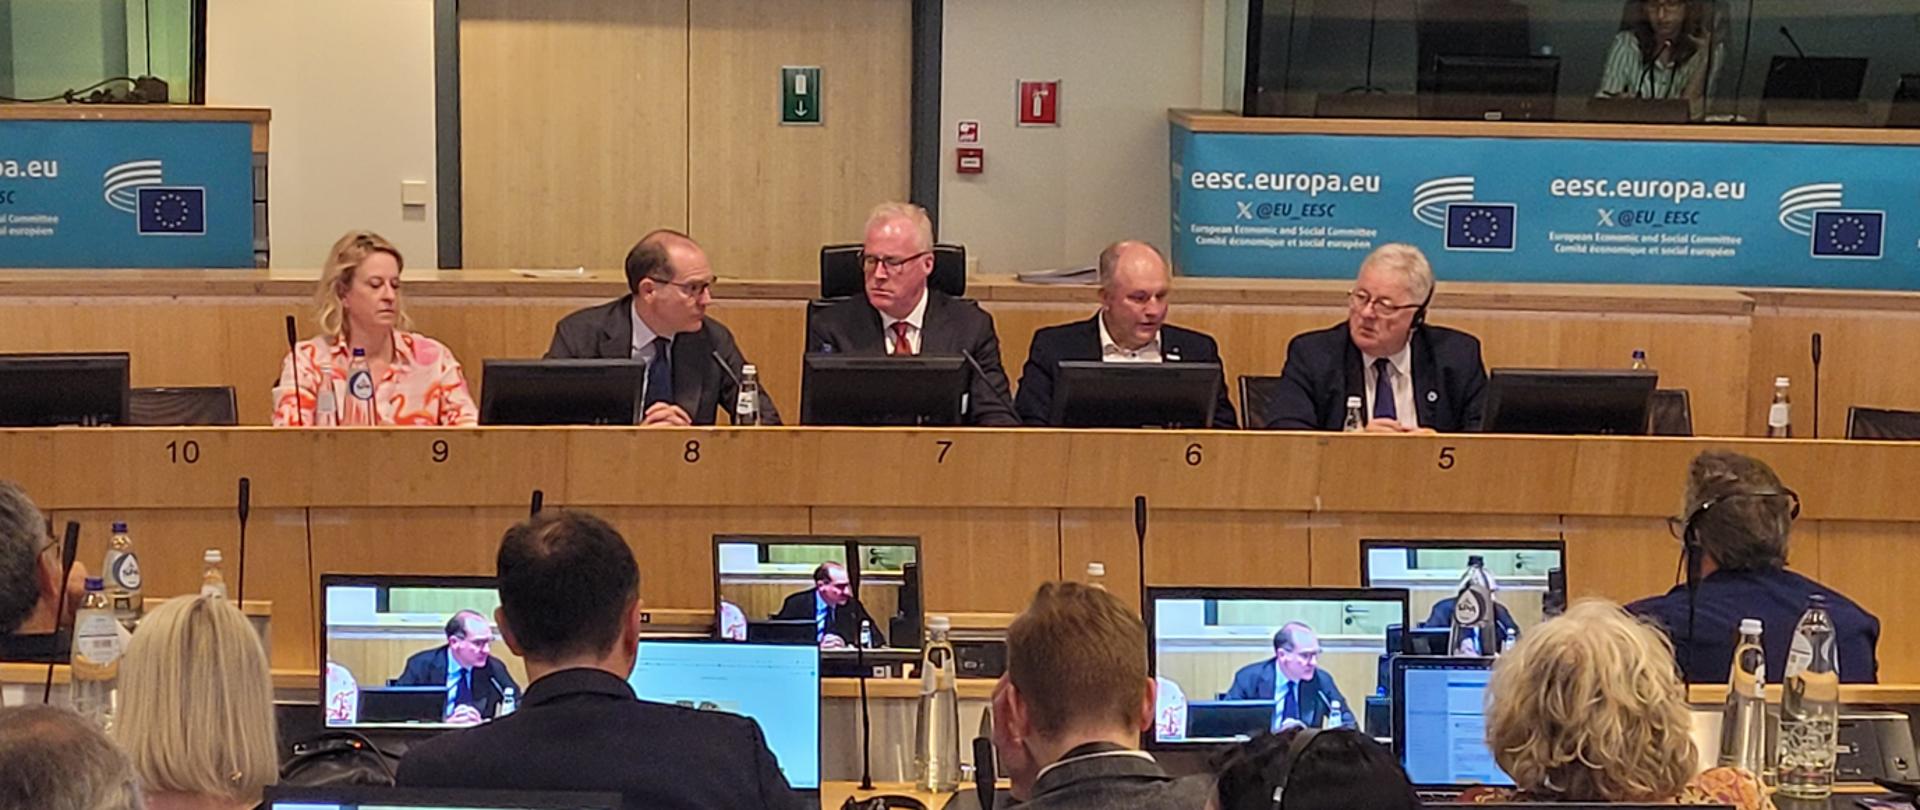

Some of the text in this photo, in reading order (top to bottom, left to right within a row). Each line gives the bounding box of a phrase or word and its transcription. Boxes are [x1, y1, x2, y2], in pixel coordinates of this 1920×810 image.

[1191, 171, 1380, 197] eesc.europa.eu
[1550, 178, 1745, 204] eesc.europa.eu
[1256, 202, 1336, 220] @EU_EESC
[1618, 209, 1700, 228] @EU_EESC
[1190, 224, 1377, 237] European Economic and Social Committee
[1549, 231, 1593, 242] European
[1661, 234, 1689, 244] Social
[1690, 234, 1742, 245] Committee
[166, 440, 200, 464] 10
[432, 440, 449, 463] 9
[684, 440, 700, 463] 8
[935, 440, 953, 464] 7
[1185, 443, 1202, 466] 6
[1438, 446, 1456, 470] 5
